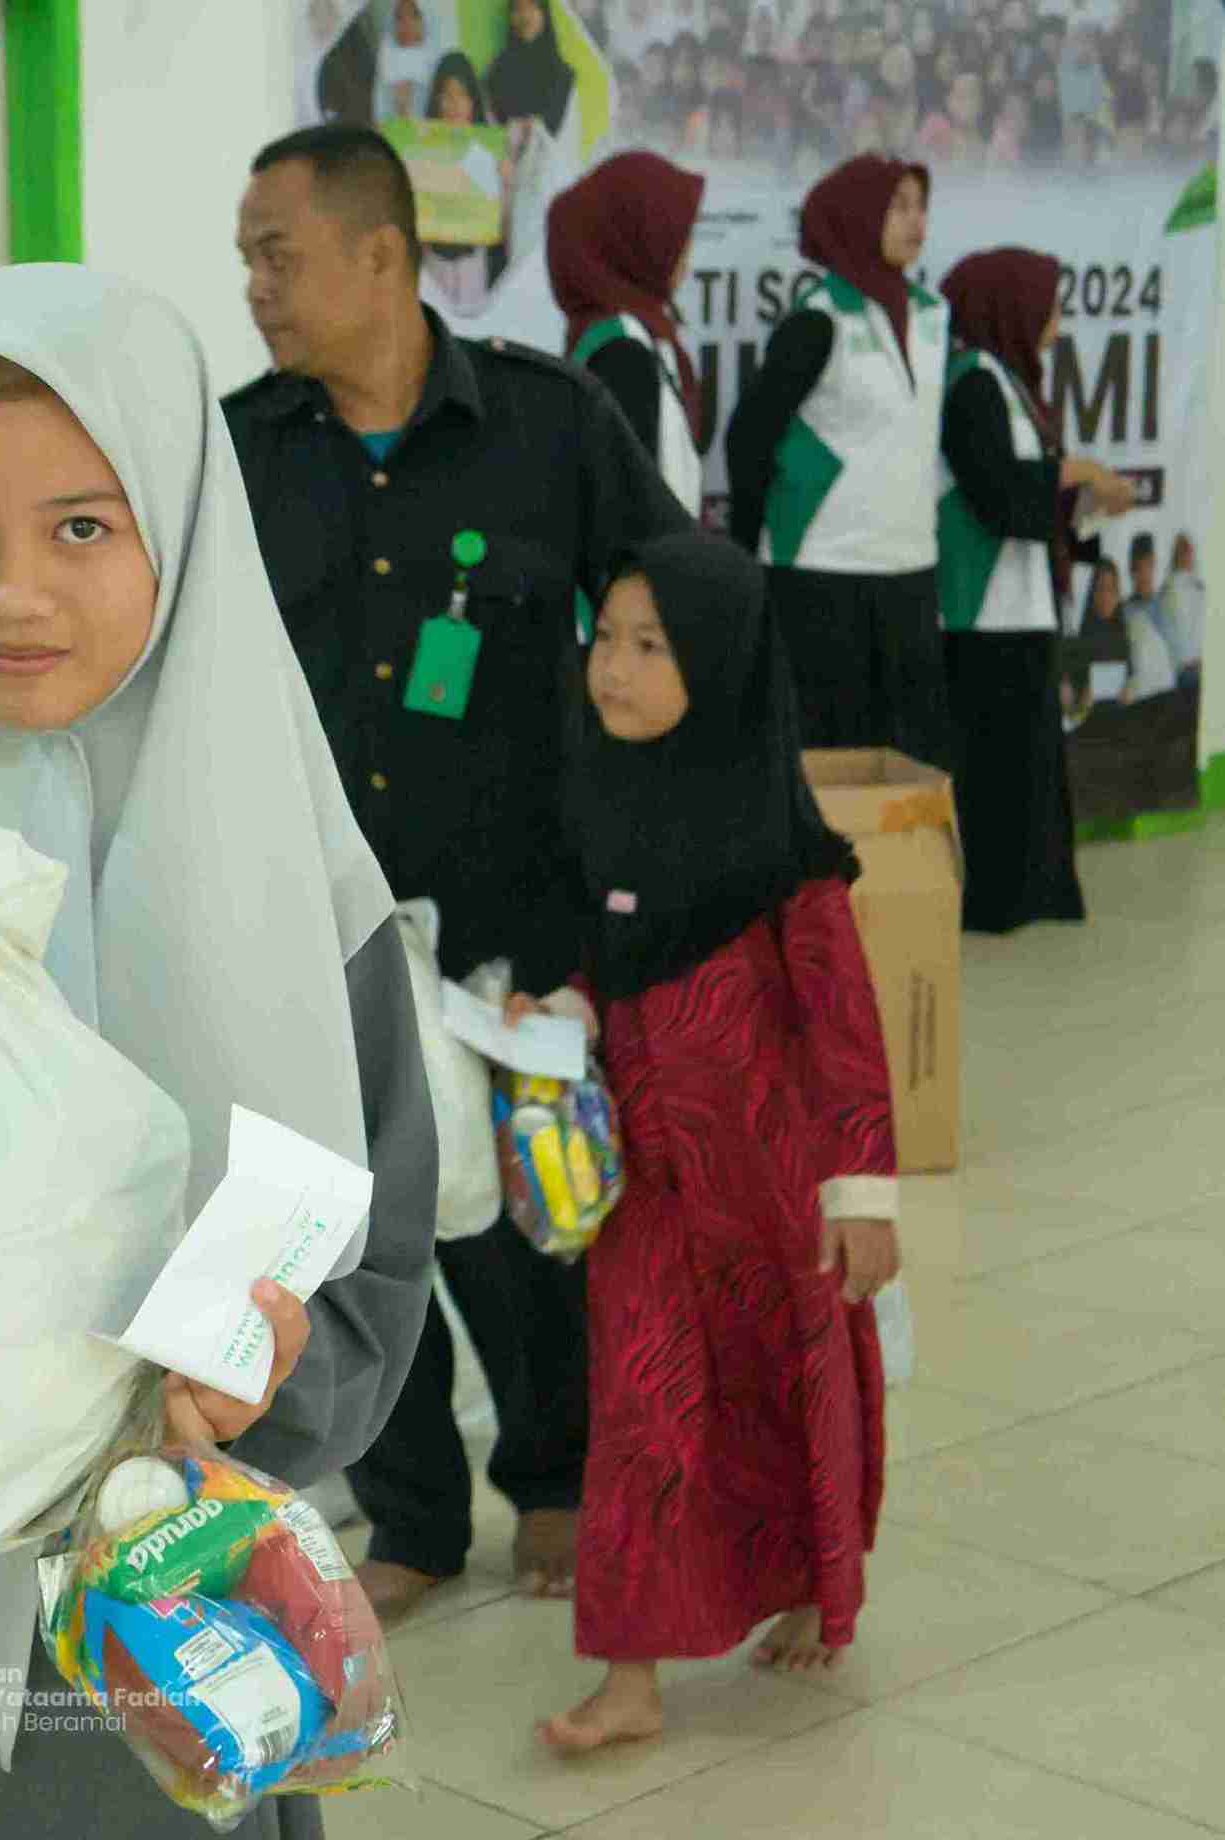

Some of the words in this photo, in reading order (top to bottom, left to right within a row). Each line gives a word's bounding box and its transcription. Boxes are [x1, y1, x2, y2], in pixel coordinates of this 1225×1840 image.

[1060, 264, 1162, 318] 2024
[1051, 332, 1161, 444] MI
[126, 1497, 223, 1573] garuda
